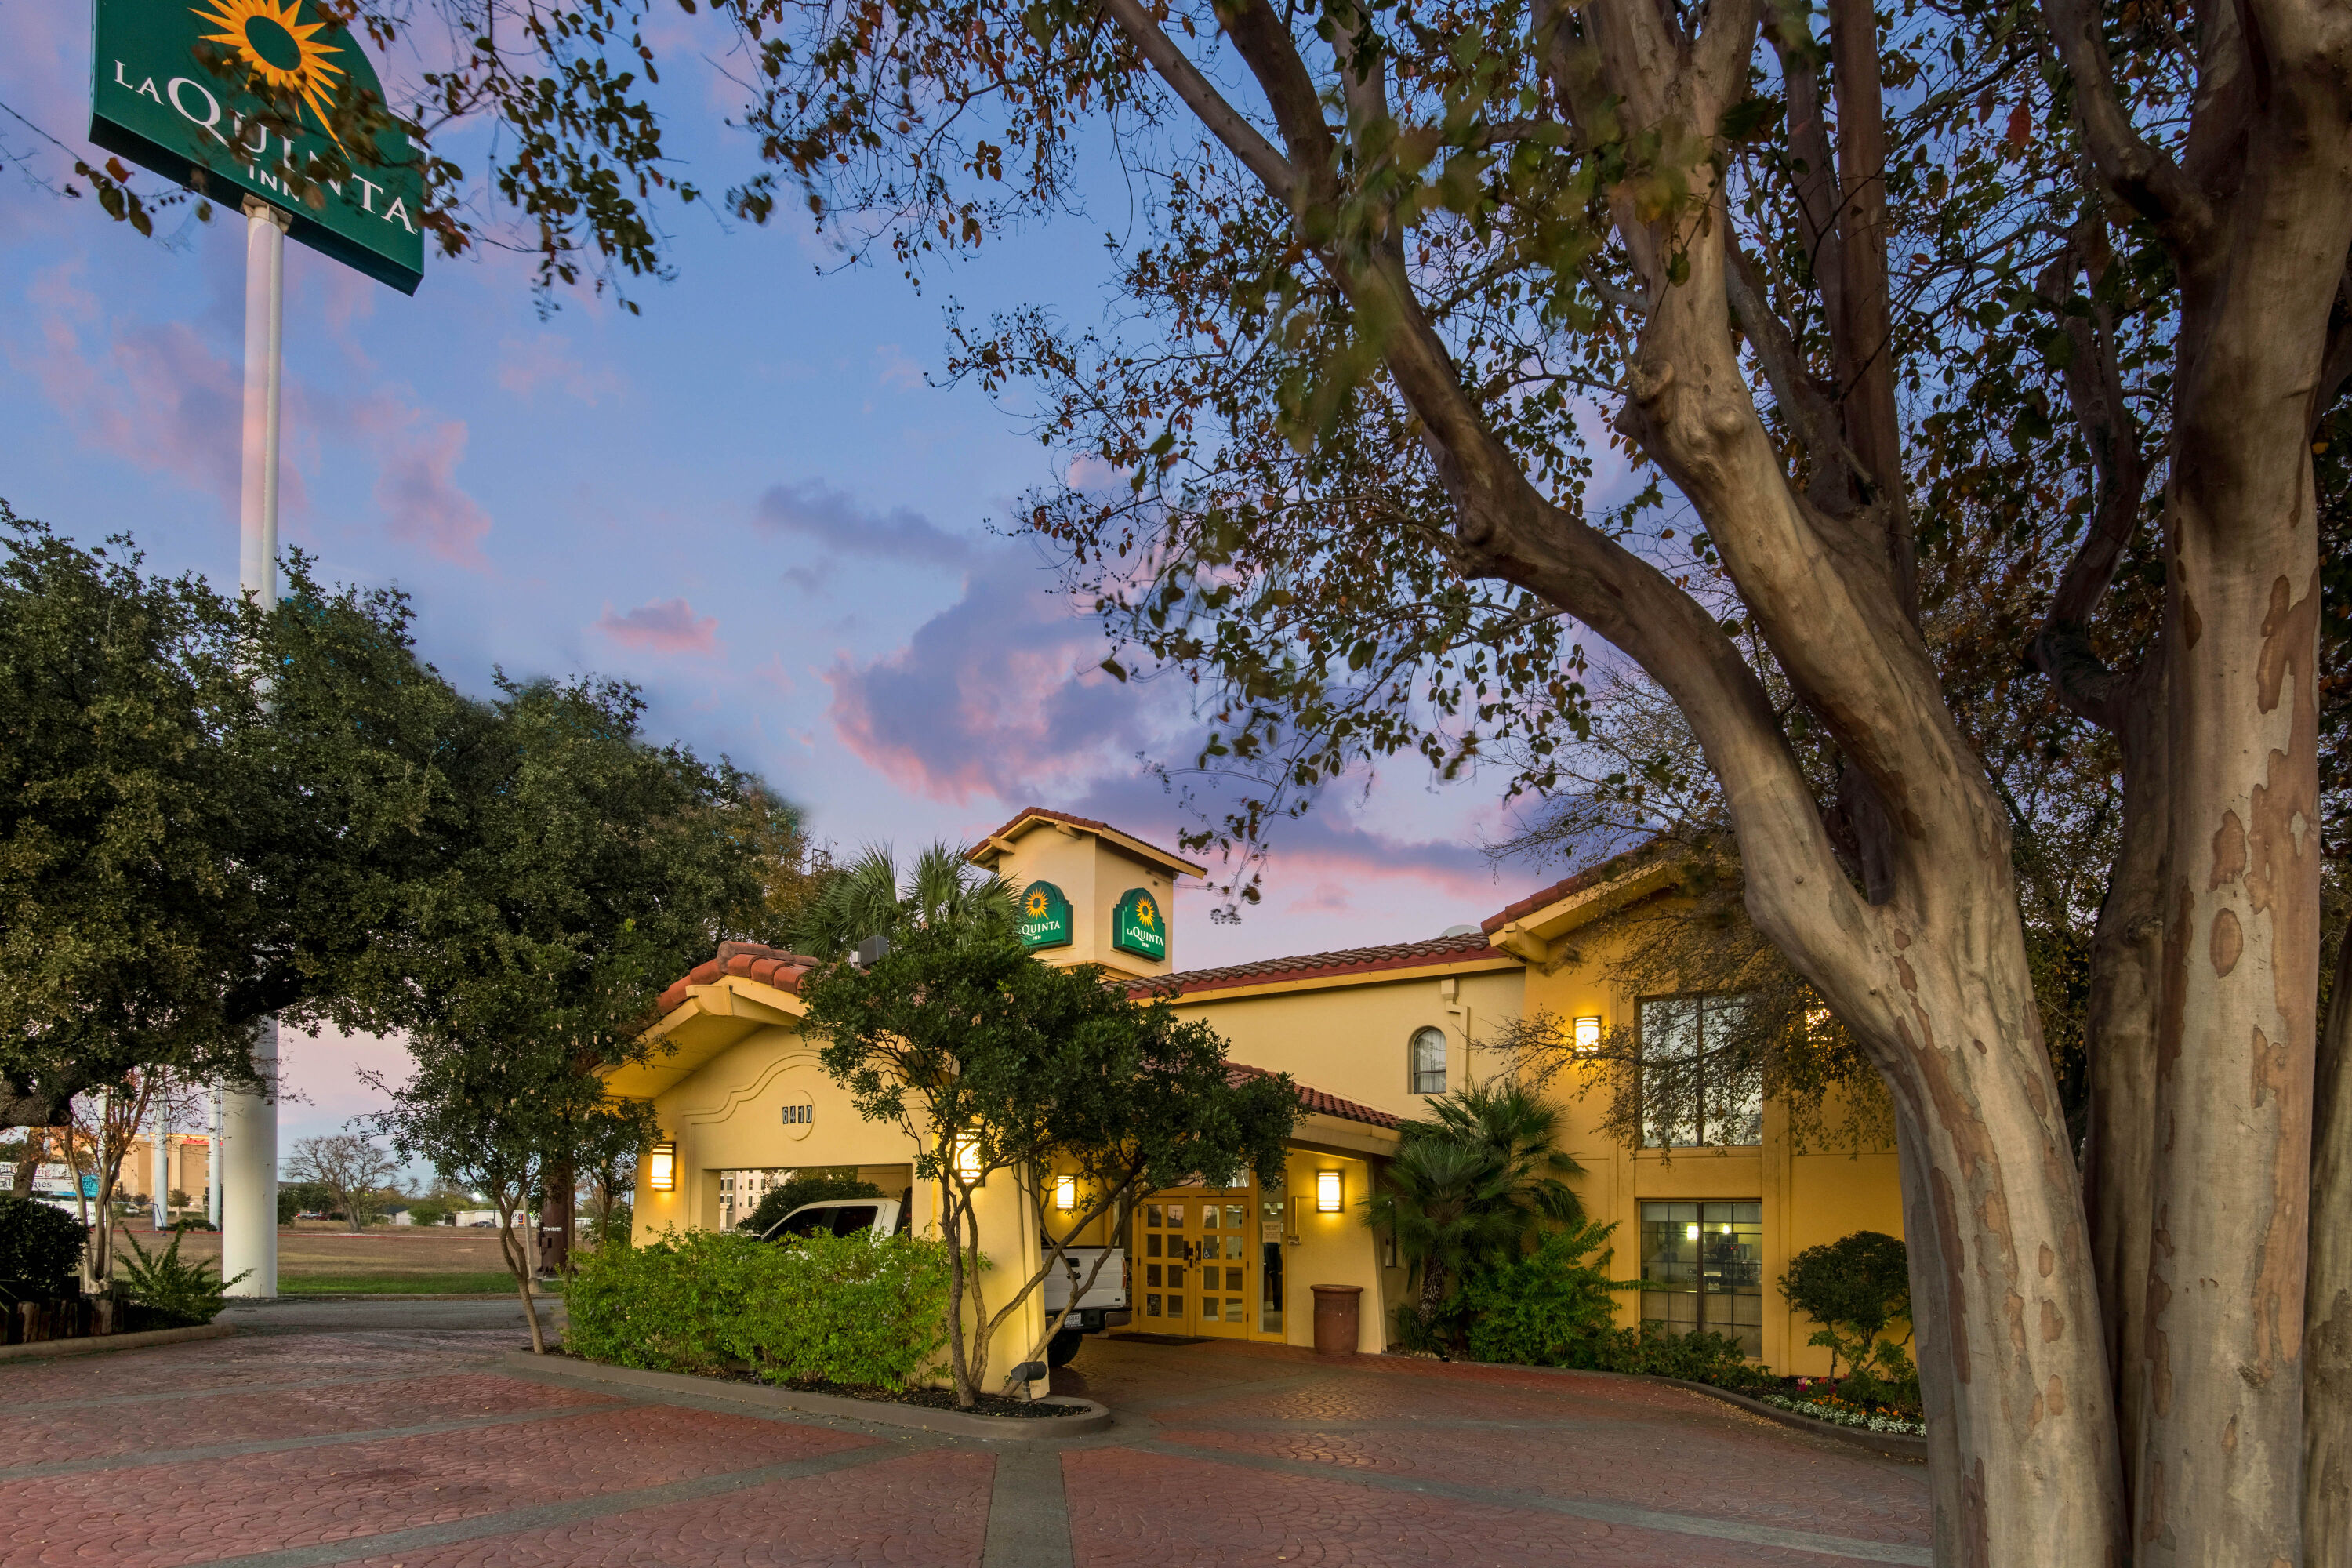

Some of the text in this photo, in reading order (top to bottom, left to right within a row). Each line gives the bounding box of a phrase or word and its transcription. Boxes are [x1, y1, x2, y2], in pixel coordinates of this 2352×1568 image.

[114, 60, 164, 106] LA
[1022, 920, 1061, 936] QUINTA
[1133, 926, 1163, 946] QUINTA
[782, 1106, 812, 1123] 6410
